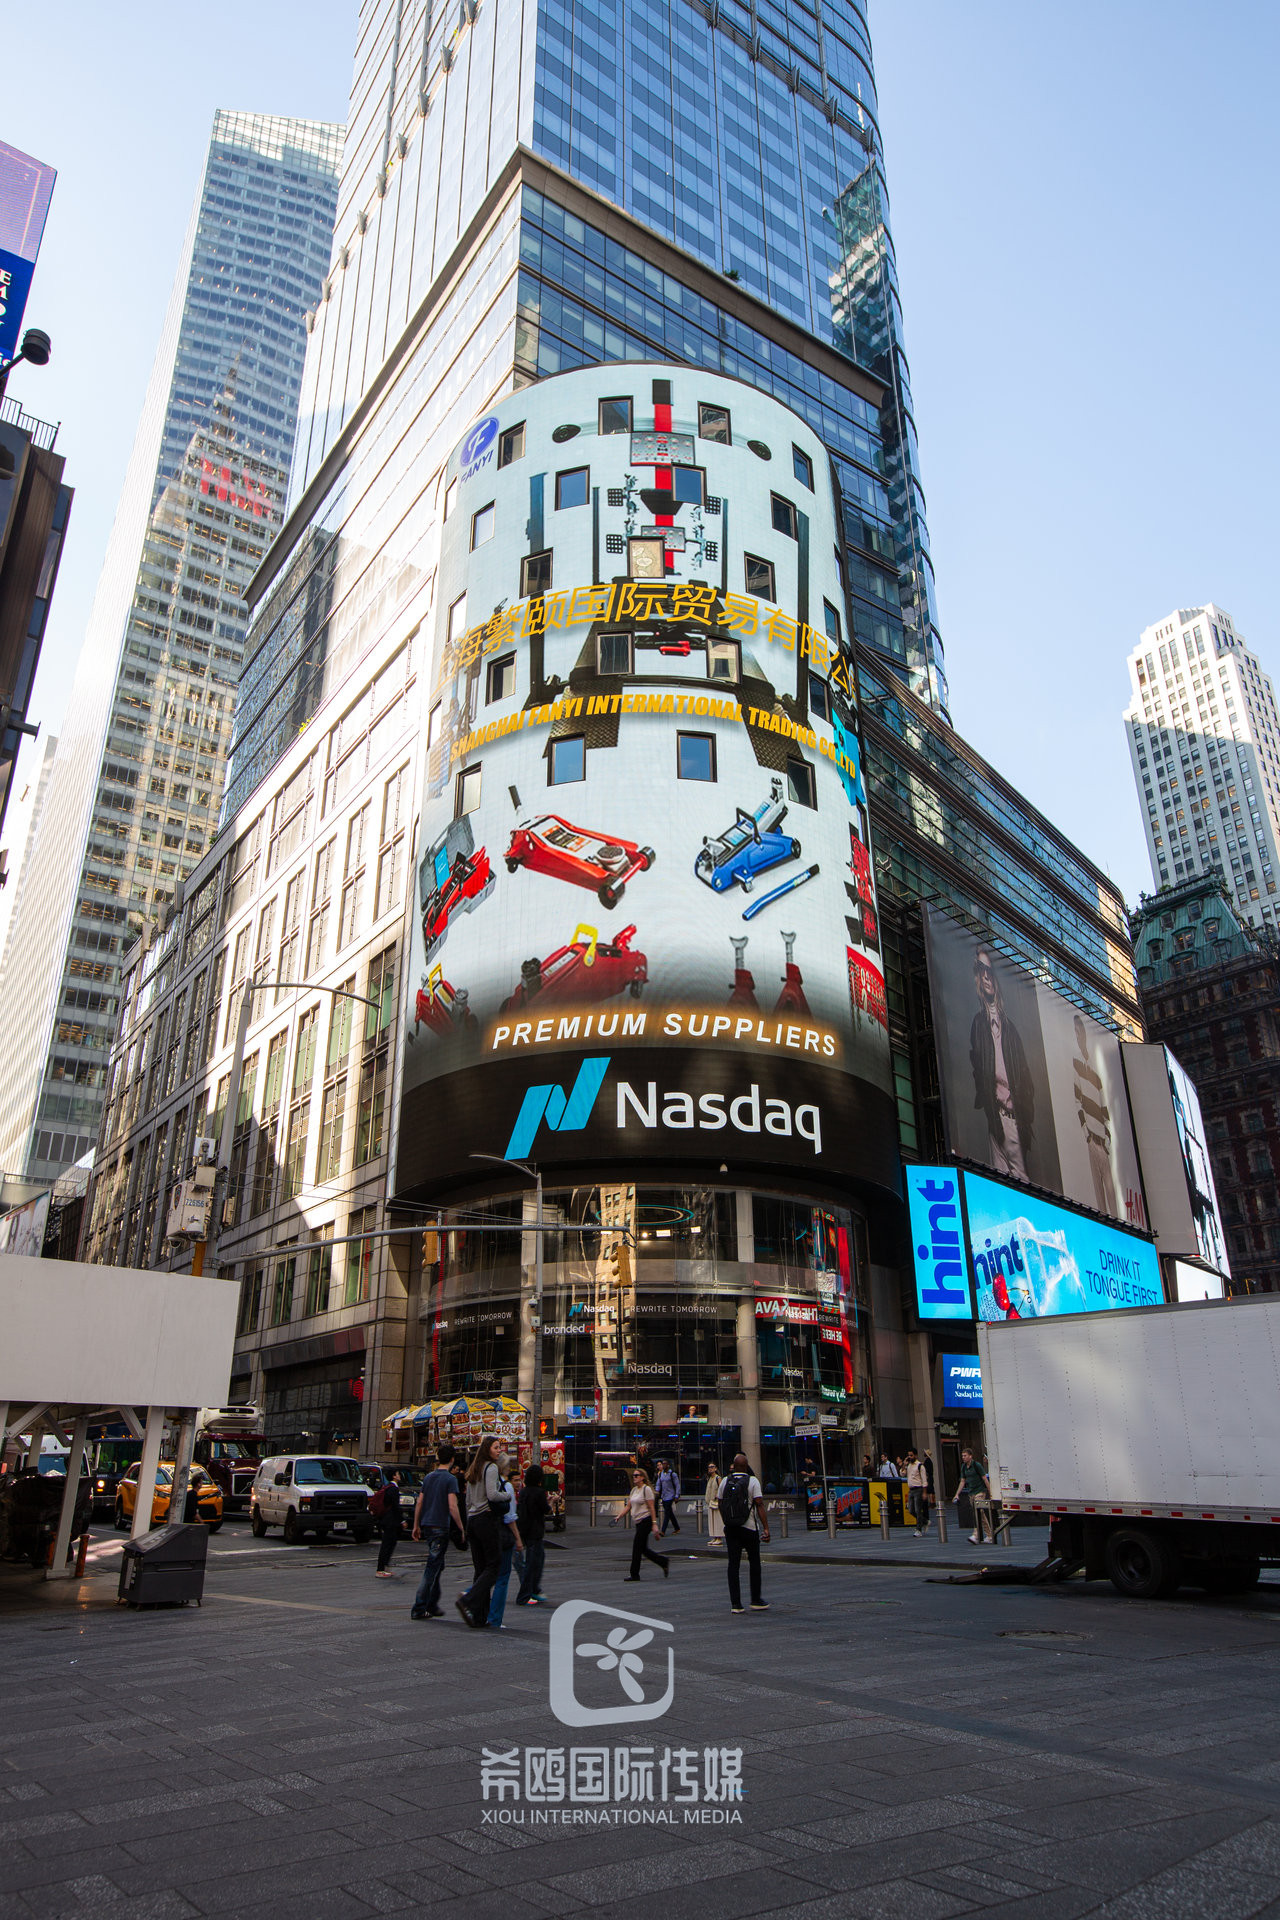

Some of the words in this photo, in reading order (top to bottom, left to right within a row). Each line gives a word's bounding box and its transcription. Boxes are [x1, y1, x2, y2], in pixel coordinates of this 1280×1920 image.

[451, 709, 526, 762] SHANGHAI
[527, 696, 584, 728] FANYI
[585, 693, 745, 723] INTERNATIONAL
[748, 706, 817, 749] TRADING
[492, 1013, 647, 1050] PREMIUM
[663, 1013, 836, 1057] SUPPLIERS
[616, 1080, 822, 1155] Nasdaq
[1125, 1187, 1145, 1229] H&M
[916, 1179, 966, 1304] hint
[972, 1233, 1024, 1290] hint
[1099, 1248, 1132, 1279] DRINK
[1132, 1260, 1140, 1282] IT
[1085, 1269, 1132, 1303] TONGUE
[1132, 1284, 1158, 1307] FIRST
[477, 1311, 513, 1322] TOMORROW
[583, 1304, 615, 1314] Nasdaq
[630, 1305, 667, 1313] REWRITE
[670, 1305, 718, 1314] TOMORROW
[627, 1362, 673, 1377] Nasdaq
[956, 1382, 972, 1390] Private
[955, 1390, 972, 1399] Nasdaq
